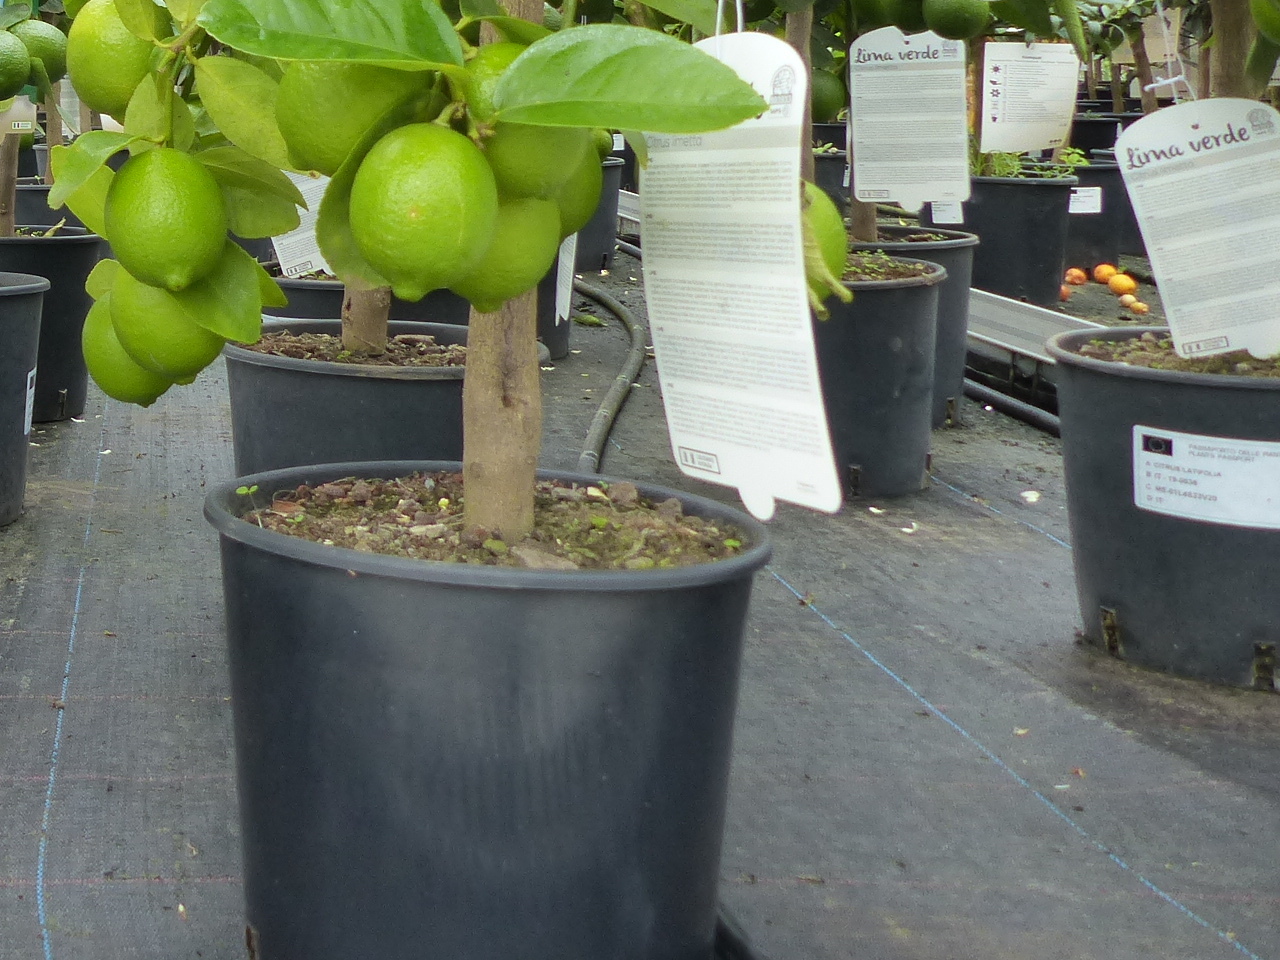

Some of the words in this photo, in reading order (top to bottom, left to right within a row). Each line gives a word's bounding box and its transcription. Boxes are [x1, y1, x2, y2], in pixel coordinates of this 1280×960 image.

[855, 48, 894, 63] Lima
[898, 45, 939, 60] verde
[1126, 145, 1184, 170] Lima
[1189, 123, 1250, 152] verde
